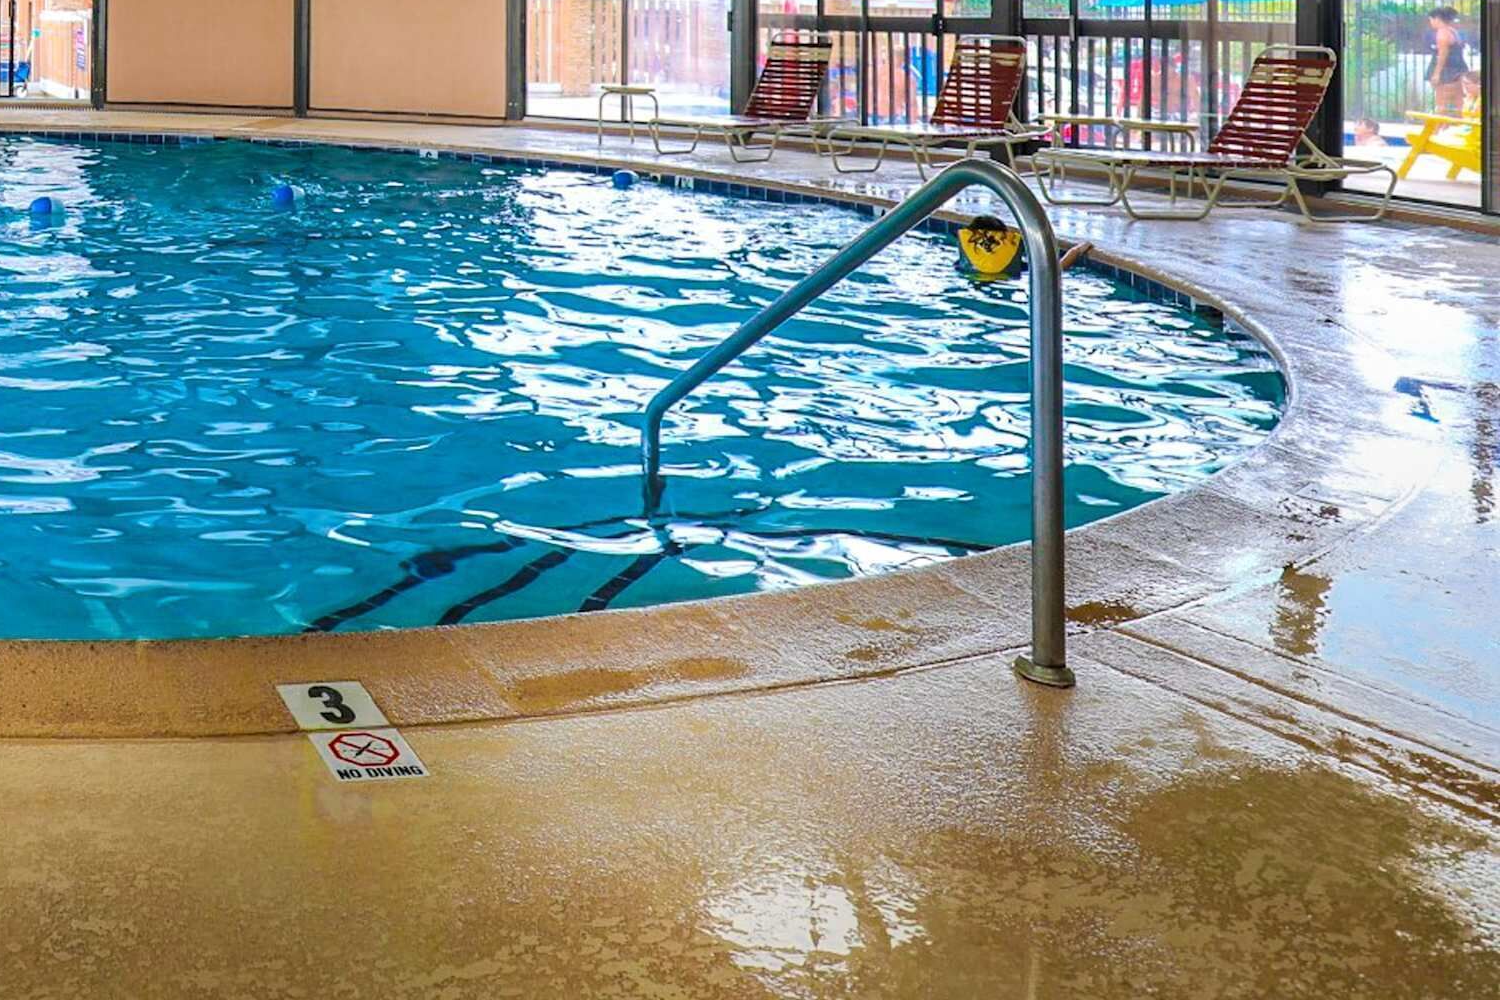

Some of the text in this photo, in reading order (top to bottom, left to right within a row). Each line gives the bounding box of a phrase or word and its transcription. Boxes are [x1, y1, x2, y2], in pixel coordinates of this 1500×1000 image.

[308, 686, 356, 724] 3
[337, 766, 424, 780] NO DIVING
